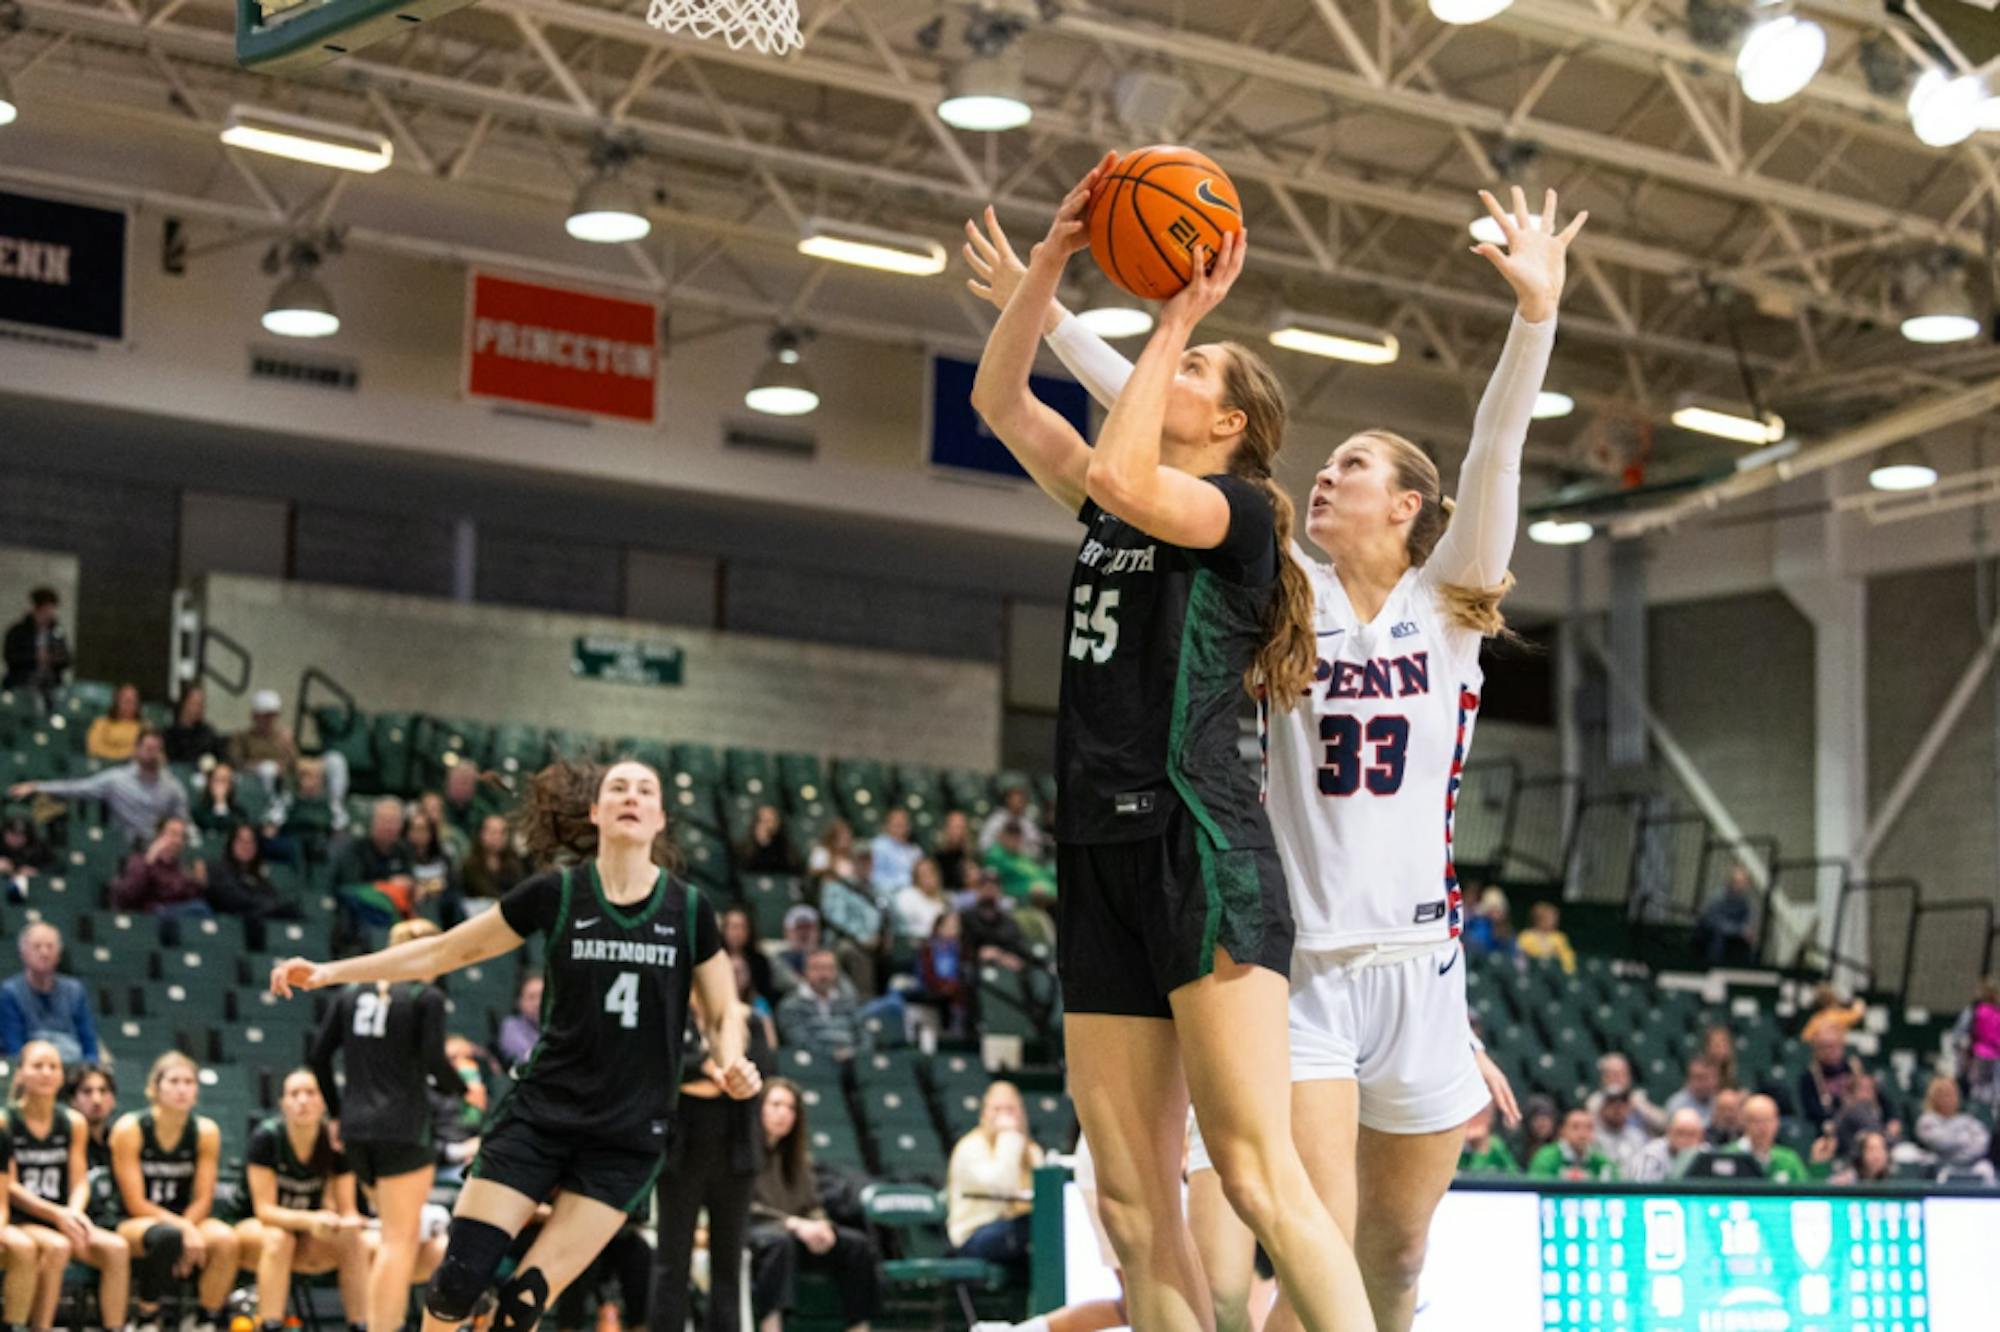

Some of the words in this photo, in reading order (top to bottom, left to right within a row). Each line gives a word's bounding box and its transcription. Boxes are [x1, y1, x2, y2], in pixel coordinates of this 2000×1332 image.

[0, 234, 71, 286] ENN
[476, 316, 651, 379] PRINCETON
[1302, 652, 1429, 700] PENN
[1317, 714, 1410, 796] 33
[572, 939, 677, 967] DARTMOUTH
[354, 992, 390, 1037] 21
[605, 971, 639, 1028] 4
